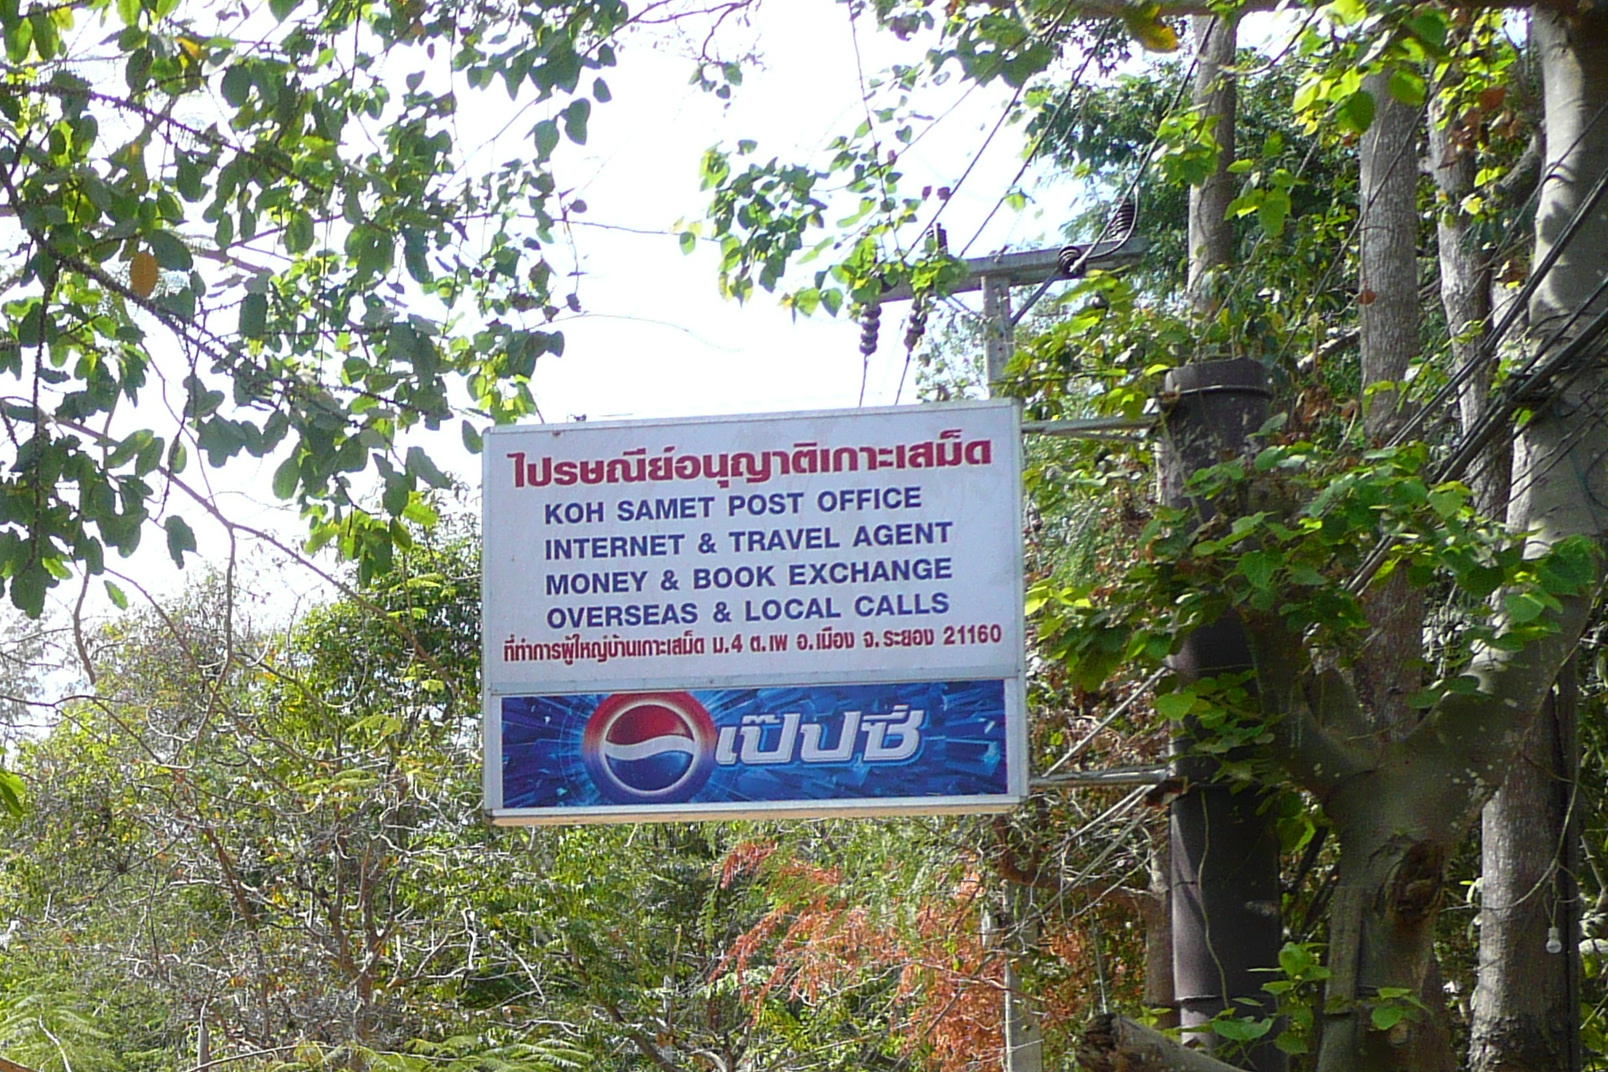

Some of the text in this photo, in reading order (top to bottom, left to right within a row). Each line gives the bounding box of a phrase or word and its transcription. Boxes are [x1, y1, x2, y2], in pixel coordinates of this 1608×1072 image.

[544, 486, 922, 525] KOH SAMET POST OFFICE
[545, 521, 953, 560] INTERNET & TRAVEL AGENT
[545, 557, 953, 596] MONEY & BOOK EXCHANGE
[546, 592, 950, 629] OVERSEAS & LOCAL CALLS
[943, 624, 1002, 646] 21160
